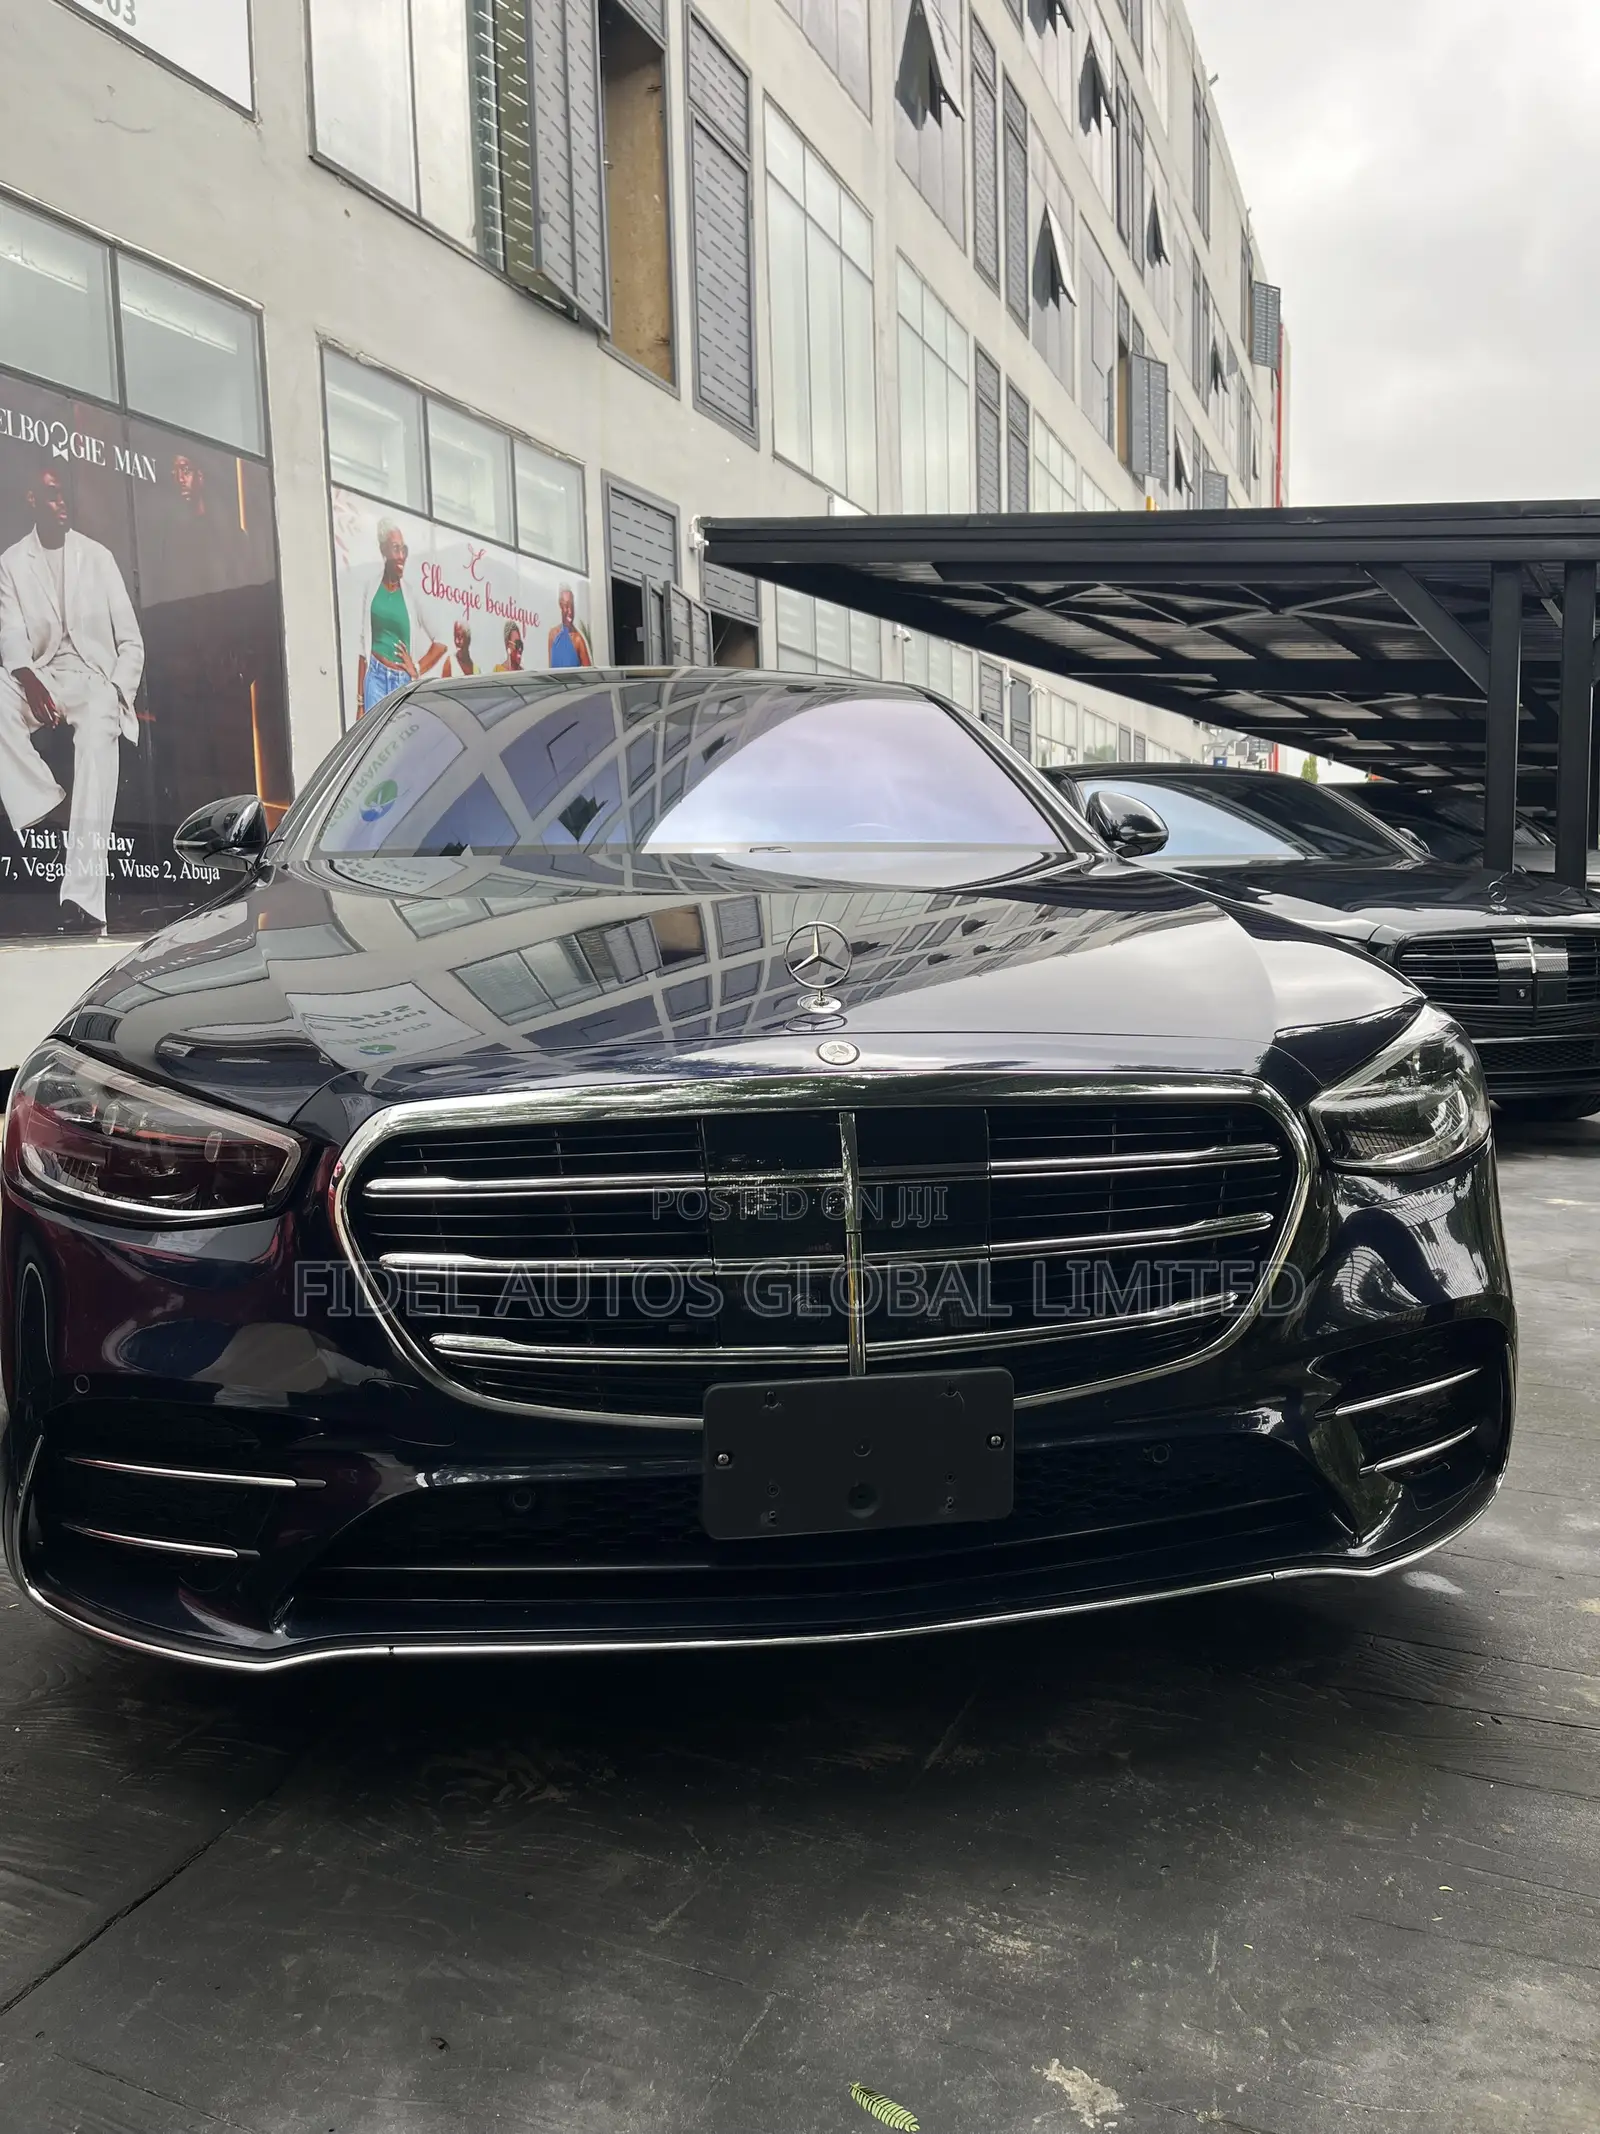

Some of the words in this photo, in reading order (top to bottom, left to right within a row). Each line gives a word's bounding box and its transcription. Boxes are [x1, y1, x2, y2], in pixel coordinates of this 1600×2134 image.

[112, 445, 157, 483] MAN
[421, 561, 482, 621] Elboogie
[485, 581, 540, 638] boutique
[15, 828, 58, 849] Visit
[61, 830, 85, 850] Us
[88, 831, 135, 856] Today
[21, 856, 72, 882] Vegas
[117, 858, 160, 880] Wuse
[163, 860, 177, 882] 2,
[180, 862, 221, 885] Abuja
